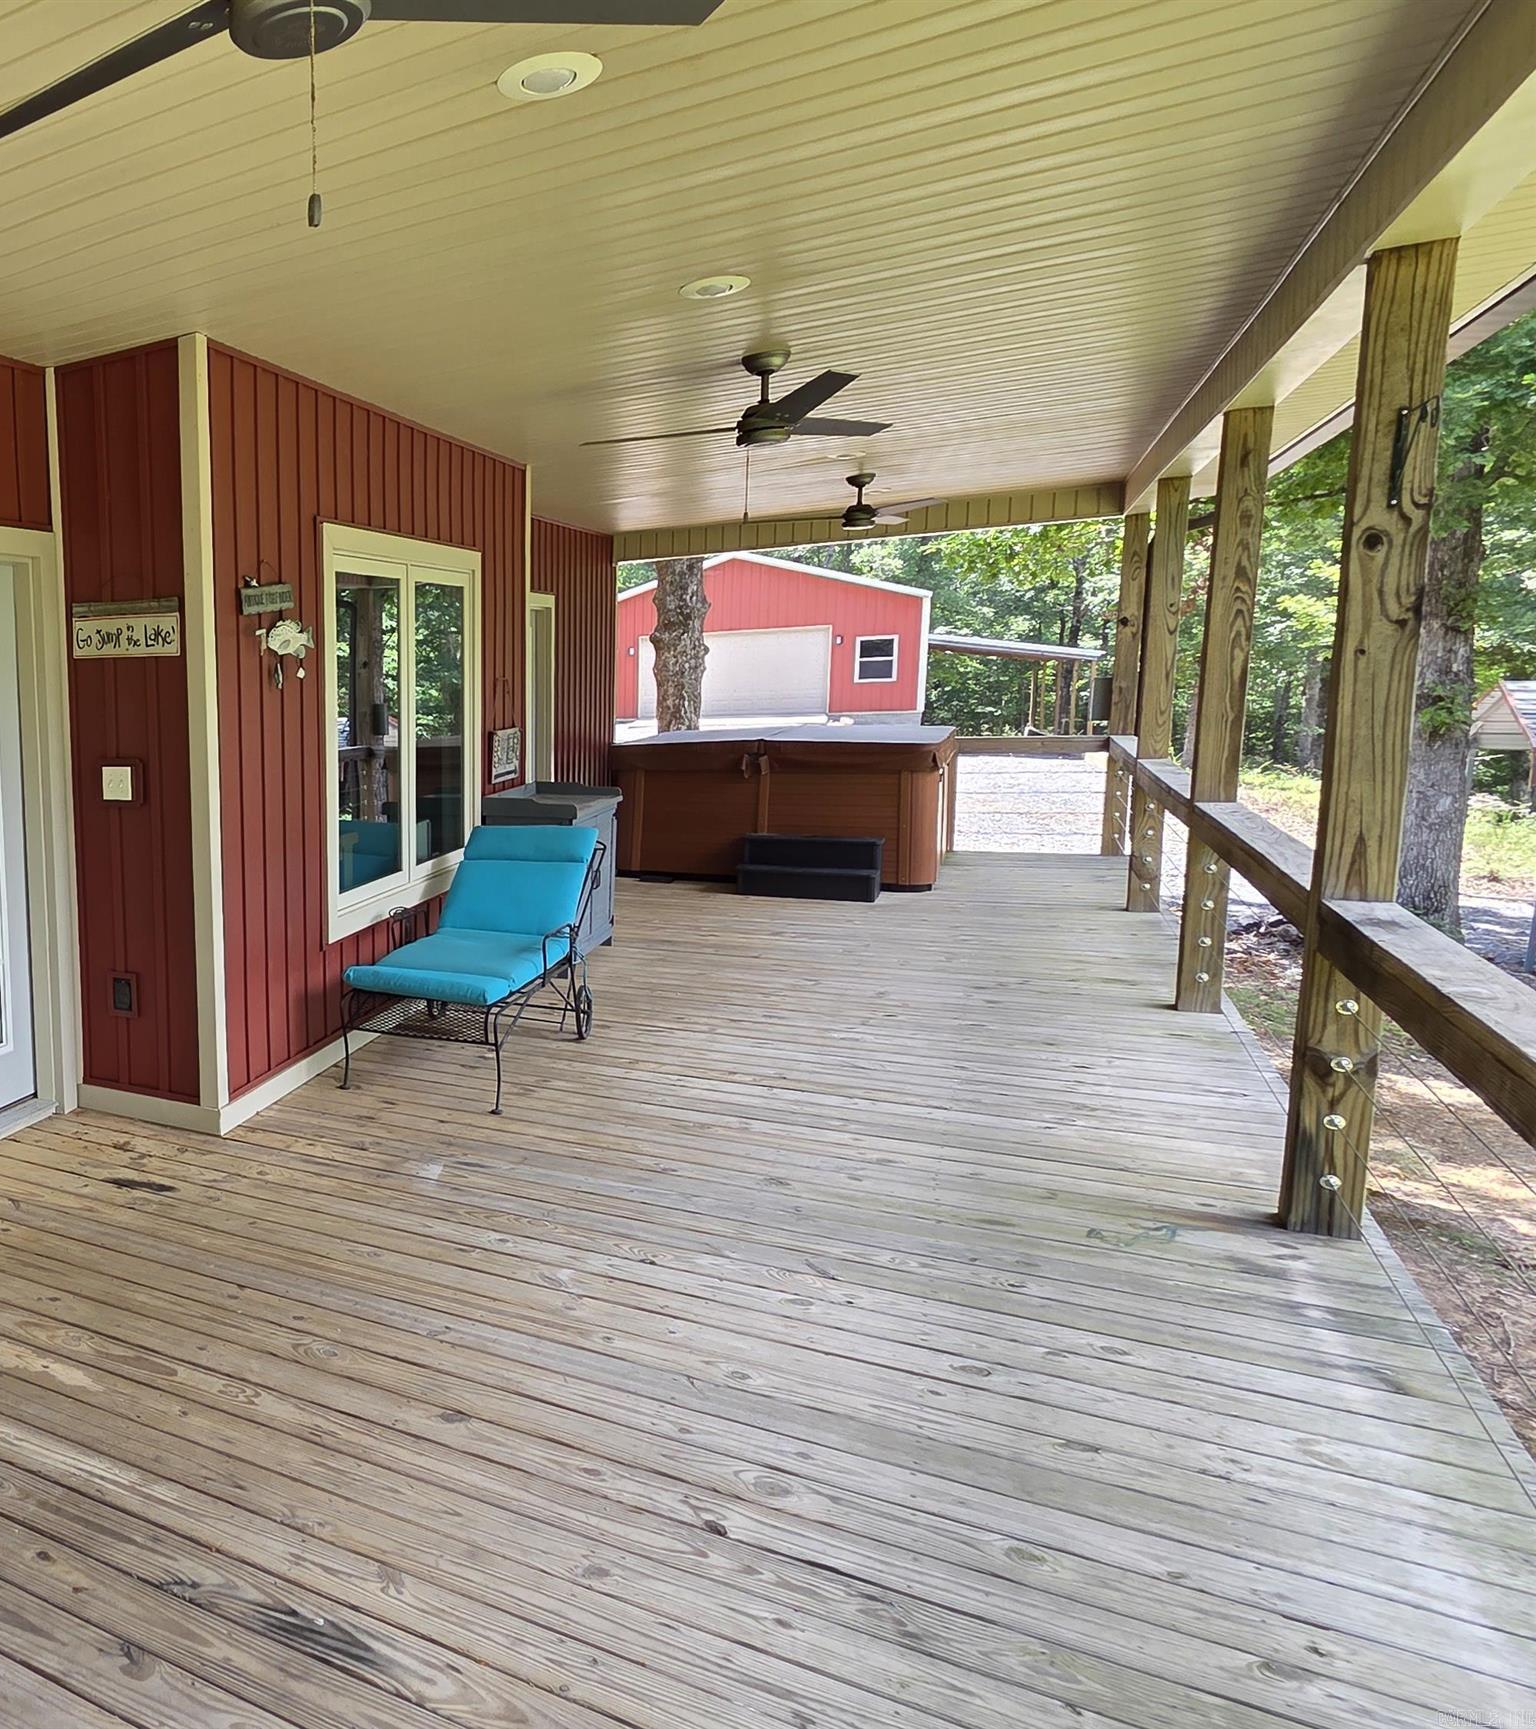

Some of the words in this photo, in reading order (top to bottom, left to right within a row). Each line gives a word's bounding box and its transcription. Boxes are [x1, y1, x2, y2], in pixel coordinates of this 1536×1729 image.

[126, 623, 134, 633] in
[76, 627, 92, 650] Go
[125, 634, 142, 648] the
